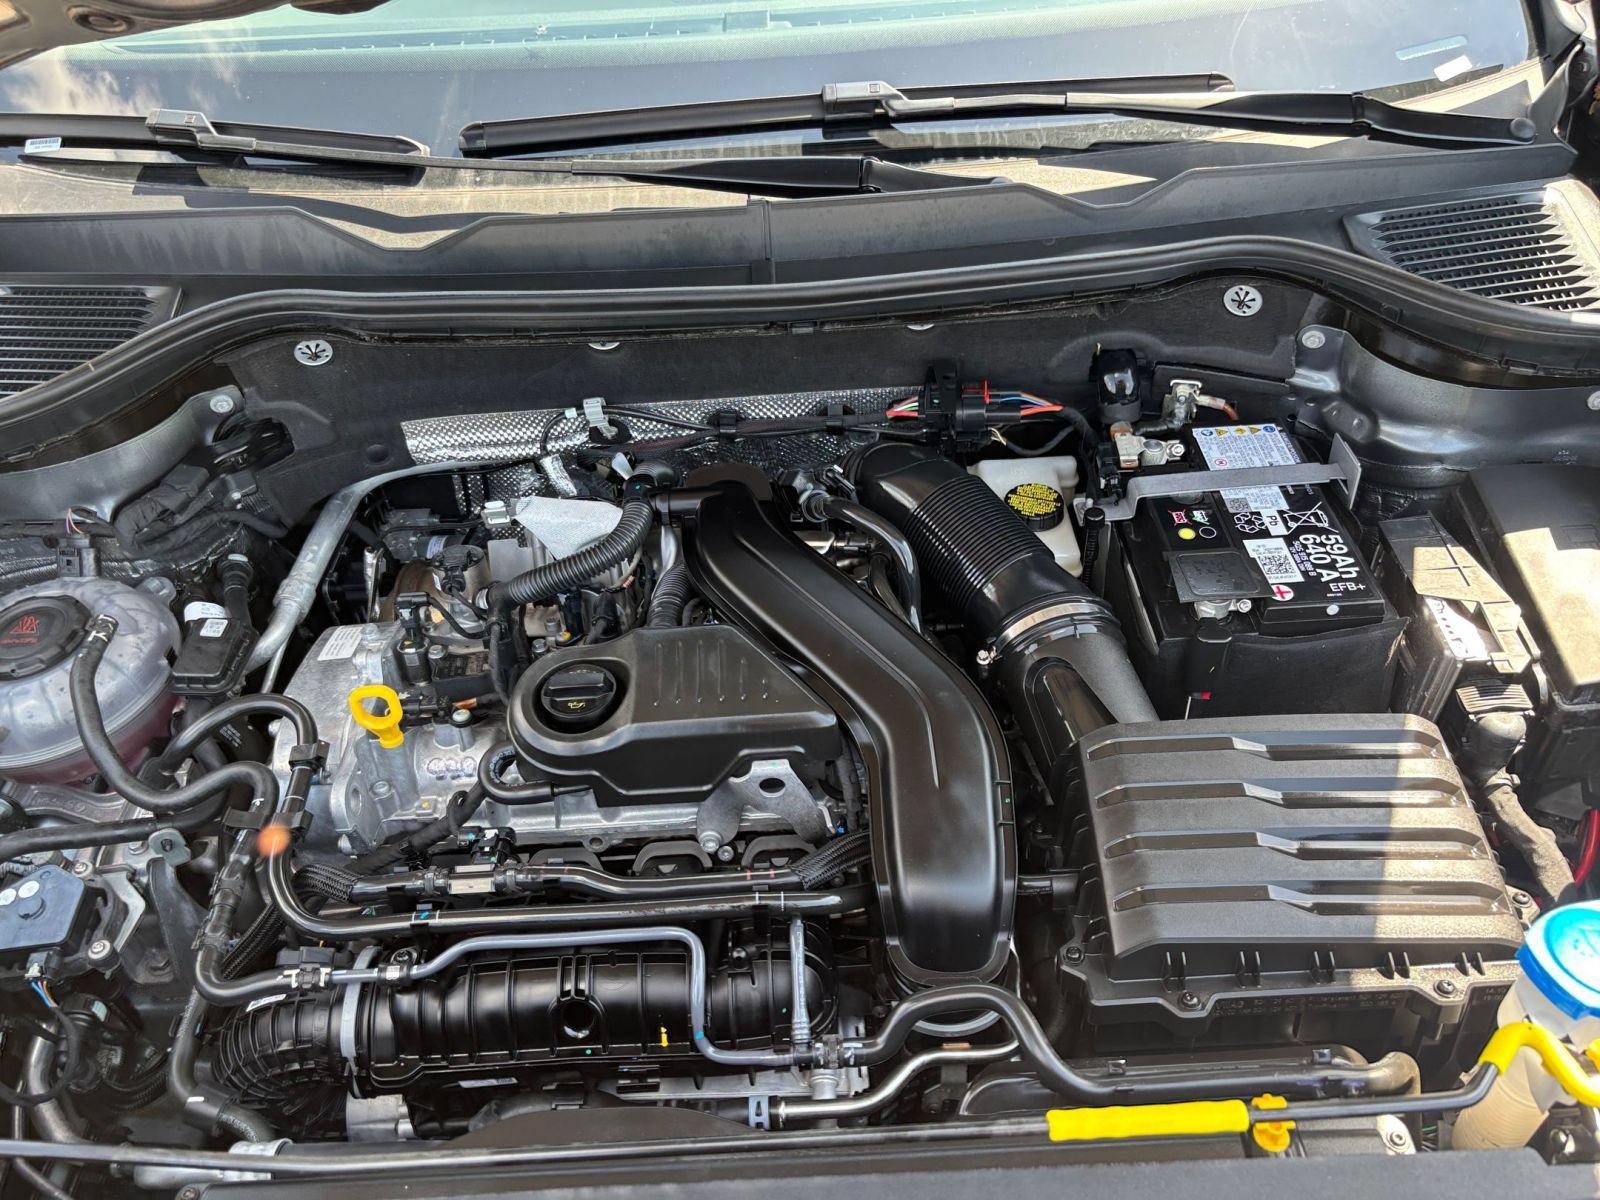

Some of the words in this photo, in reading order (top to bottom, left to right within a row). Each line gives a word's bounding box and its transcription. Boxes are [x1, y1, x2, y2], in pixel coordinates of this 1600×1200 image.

[1266, 515, 1279, 527] Pb
[1298, 534, 1331, 564] 640
[1315, 568, 1341, 583] A
[1320, 534, 1360, 579] 59Ah
[1329, 582, 1366, 592] EFB+
